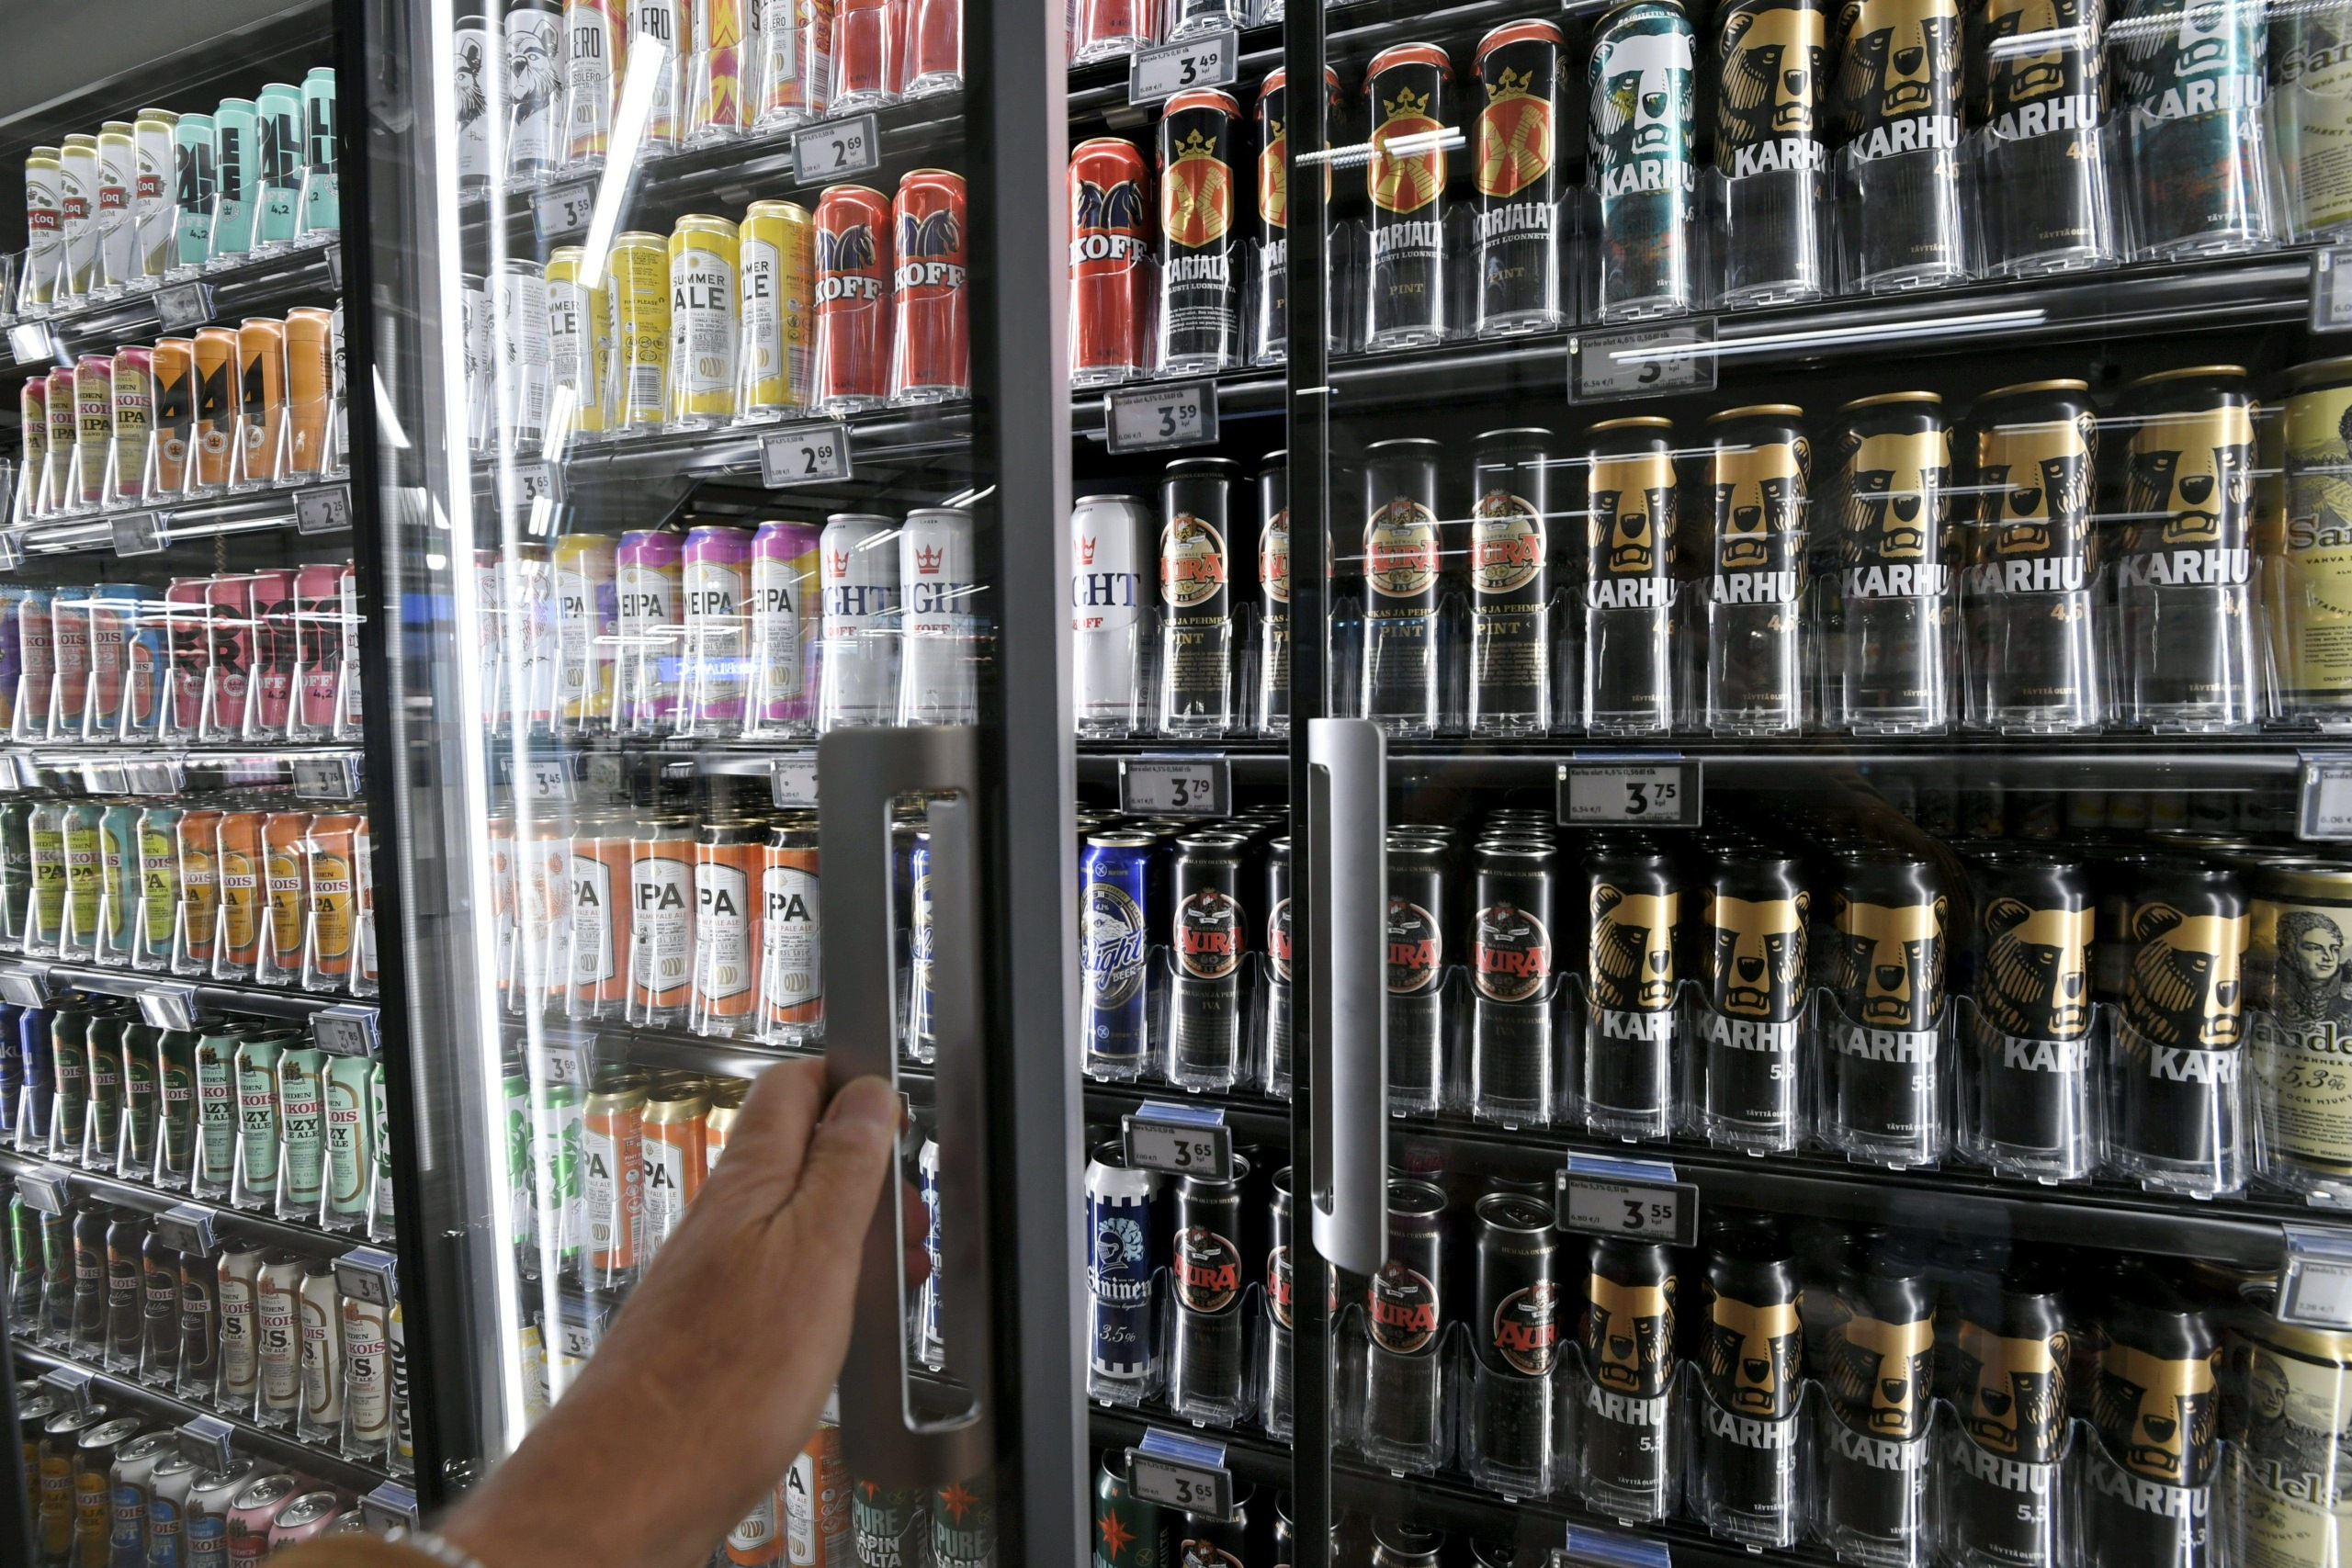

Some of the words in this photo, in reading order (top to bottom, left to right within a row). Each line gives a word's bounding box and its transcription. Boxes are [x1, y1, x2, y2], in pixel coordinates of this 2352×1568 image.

[1180, 57, 1196, 85] 3
[1200, 53, 1218, 66] 49
[2131, 73, 2263, 137] KARHU
[1977, 95, 2098, 158] KARHU
[831, 140, 847, 168] 2
[847, 136, 862, 151] 69
[1848, 115, 1959, 172] KARHU
[1600, 158, 1696, 199] KARHU
[564, 202, 577, 227] 3
[578, 199, 589, 211] 55
[1472, 202, 1549, 245] KARJALA
[1069, 234, 1148, 267] KOFF
[673, 275, 725, 287] SUMMER
[815, 276, 882, 302] KOFF
[895, 262, 966, 293] KOFF
[1389, 283, 1423, 296] PINT
[674, 287, 725, 312] ALE
[1582, 339, 1602, 348] Karhu
[1583, 378, 1600, 388] 6.34
[1158, 406, 1176, 437] 3
[1179, 404, 1197, 419] 59
[1118, 432, 1132, 440] 6.06
[801, 447, 817, 474] 2
[818, 446, 832, 458] 69
[525, 476, 537, 501] 3
[1363, 540, 1443, 575] AURA
[1470, 533, 1546, 569] AURA
[2306, 556, 2345, 565] VAHVA
[1160, 552, 1227, 584] AURA
[1842, 564, 1950, 598] KARHU
[1966, 556, 2084, 594] KARHU
[2119, 548, 2250, 588] KARHU
[1584, 578, 1676, 609] KARHU
[1696, 571, 1797, 605] KARHU
[1380, 626, 1423, 637] PINT
[1477, 622, 1521, 636] PINT
[538, 773, 549, 795] 3
[1571, 769, 1589, 777] Karhu
[1589, 768, 1602, 777] olut
[1171, 779, 1189, 807] 3
[1192, 780, 1210, 793] 79
[1625, 783, 1648, 815] 3
[1655, 784, 1676, 798] 75
[1656, 799, 1666, 807] kpl
[635, 883, 685, 910] IPA
[764, 892, 810, 922] IPA
[1174, 924, 1246, 955] AURA
[1113, 967, 1136, 983] BEER
[1696, 1015, 1798, 1053] KARHU
[1828, 1024, 1938, 1064] KARHU
[551, 1059, 564, 1078] 3
[1173, 1140, 1192, 1167] 3
[1194, 1144, 1212, 1156] 65
[1570, 1181, 1588, 1190] Karhu
[1570, 1214, 1588, 1223] 6.80
[1623, 1200, 1645, 1229] 3
[1651, 1204, 1672, 1219] 55
[1099, 1323, 1136, 1343] 3,5%
[1575, 1380, 1663, 1426] KARHU
[1704, 1405, 1798, 1450] KARHU
[1830, 1424, 1928, 1471] KARHU
[1175, 1478, 1193, 1504] 3
[1195, 1484, 1213, 1497] 65
[2086, 1453, 2210, 1518] KARHU
